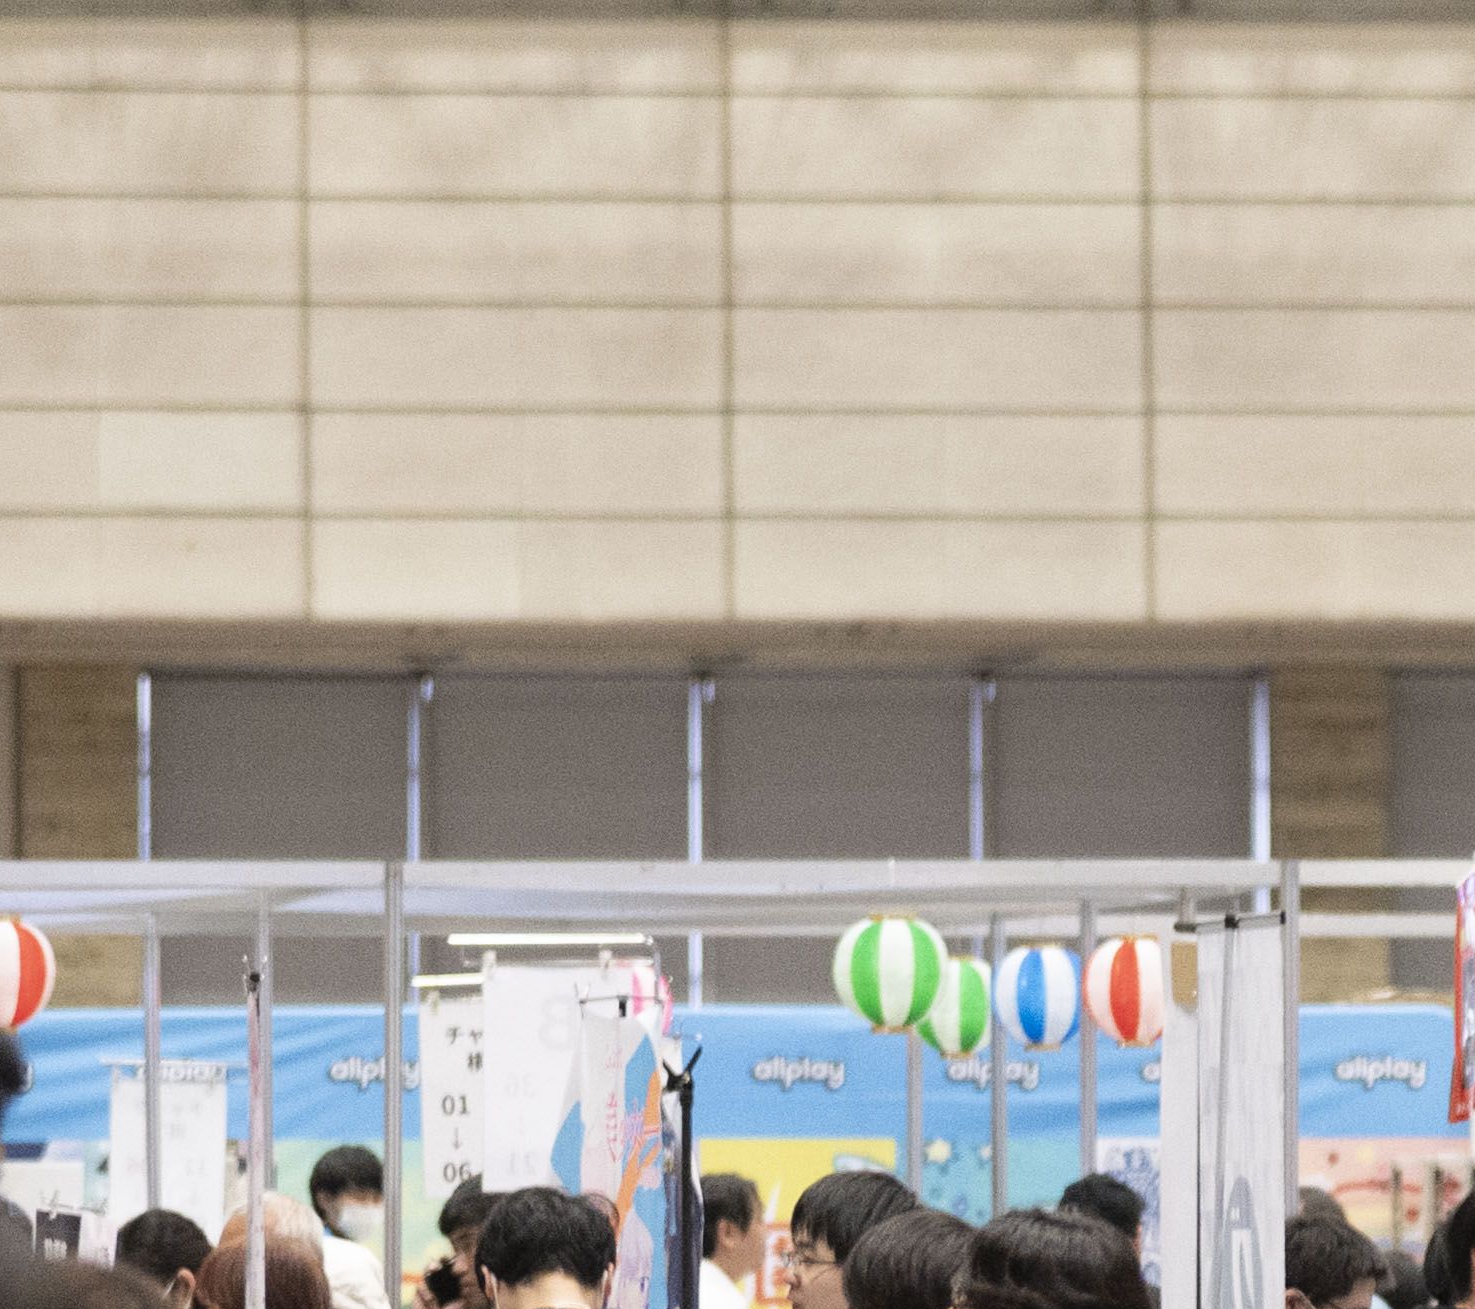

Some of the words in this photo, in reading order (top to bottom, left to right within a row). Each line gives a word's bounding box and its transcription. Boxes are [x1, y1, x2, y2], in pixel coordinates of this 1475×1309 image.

[330, 1056, 422, 1090] allply
[752, 1055, 845, 1090] allplay
[947, 1056, 1040, 1090] allpay
[1335, 1055, 1426, 1089] allplay
[440, 1093, 470, 1118] 01
[442, 1160, 472, 1186] 06
